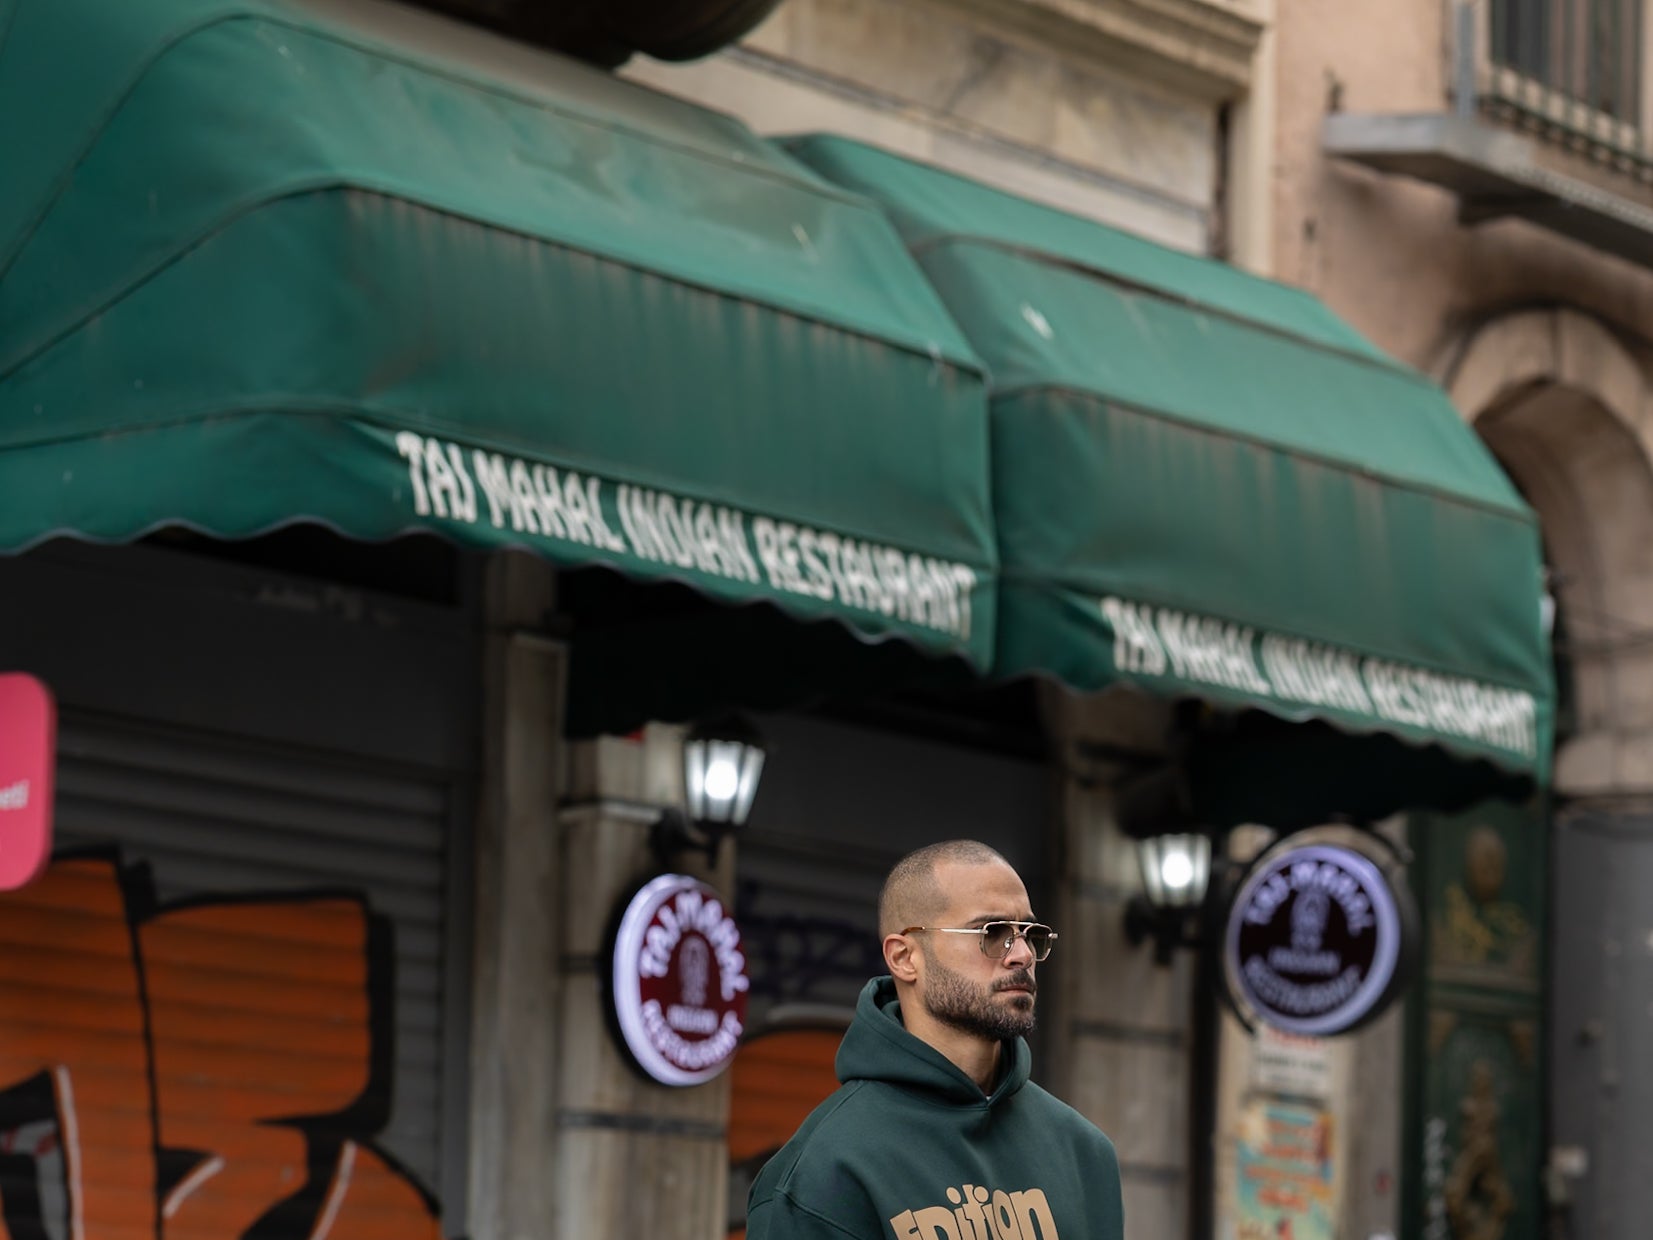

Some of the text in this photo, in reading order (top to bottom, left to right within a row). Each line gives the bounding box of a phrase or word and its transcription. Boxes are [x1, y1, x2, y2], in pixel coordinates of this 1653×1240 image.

[395, 430, 977, 641] TAJ MAHAL INDIAN RESTAURANT
[1101, 595, 1167, 676] TAJ
[1155, 607, 1271, 696] MAHAL
